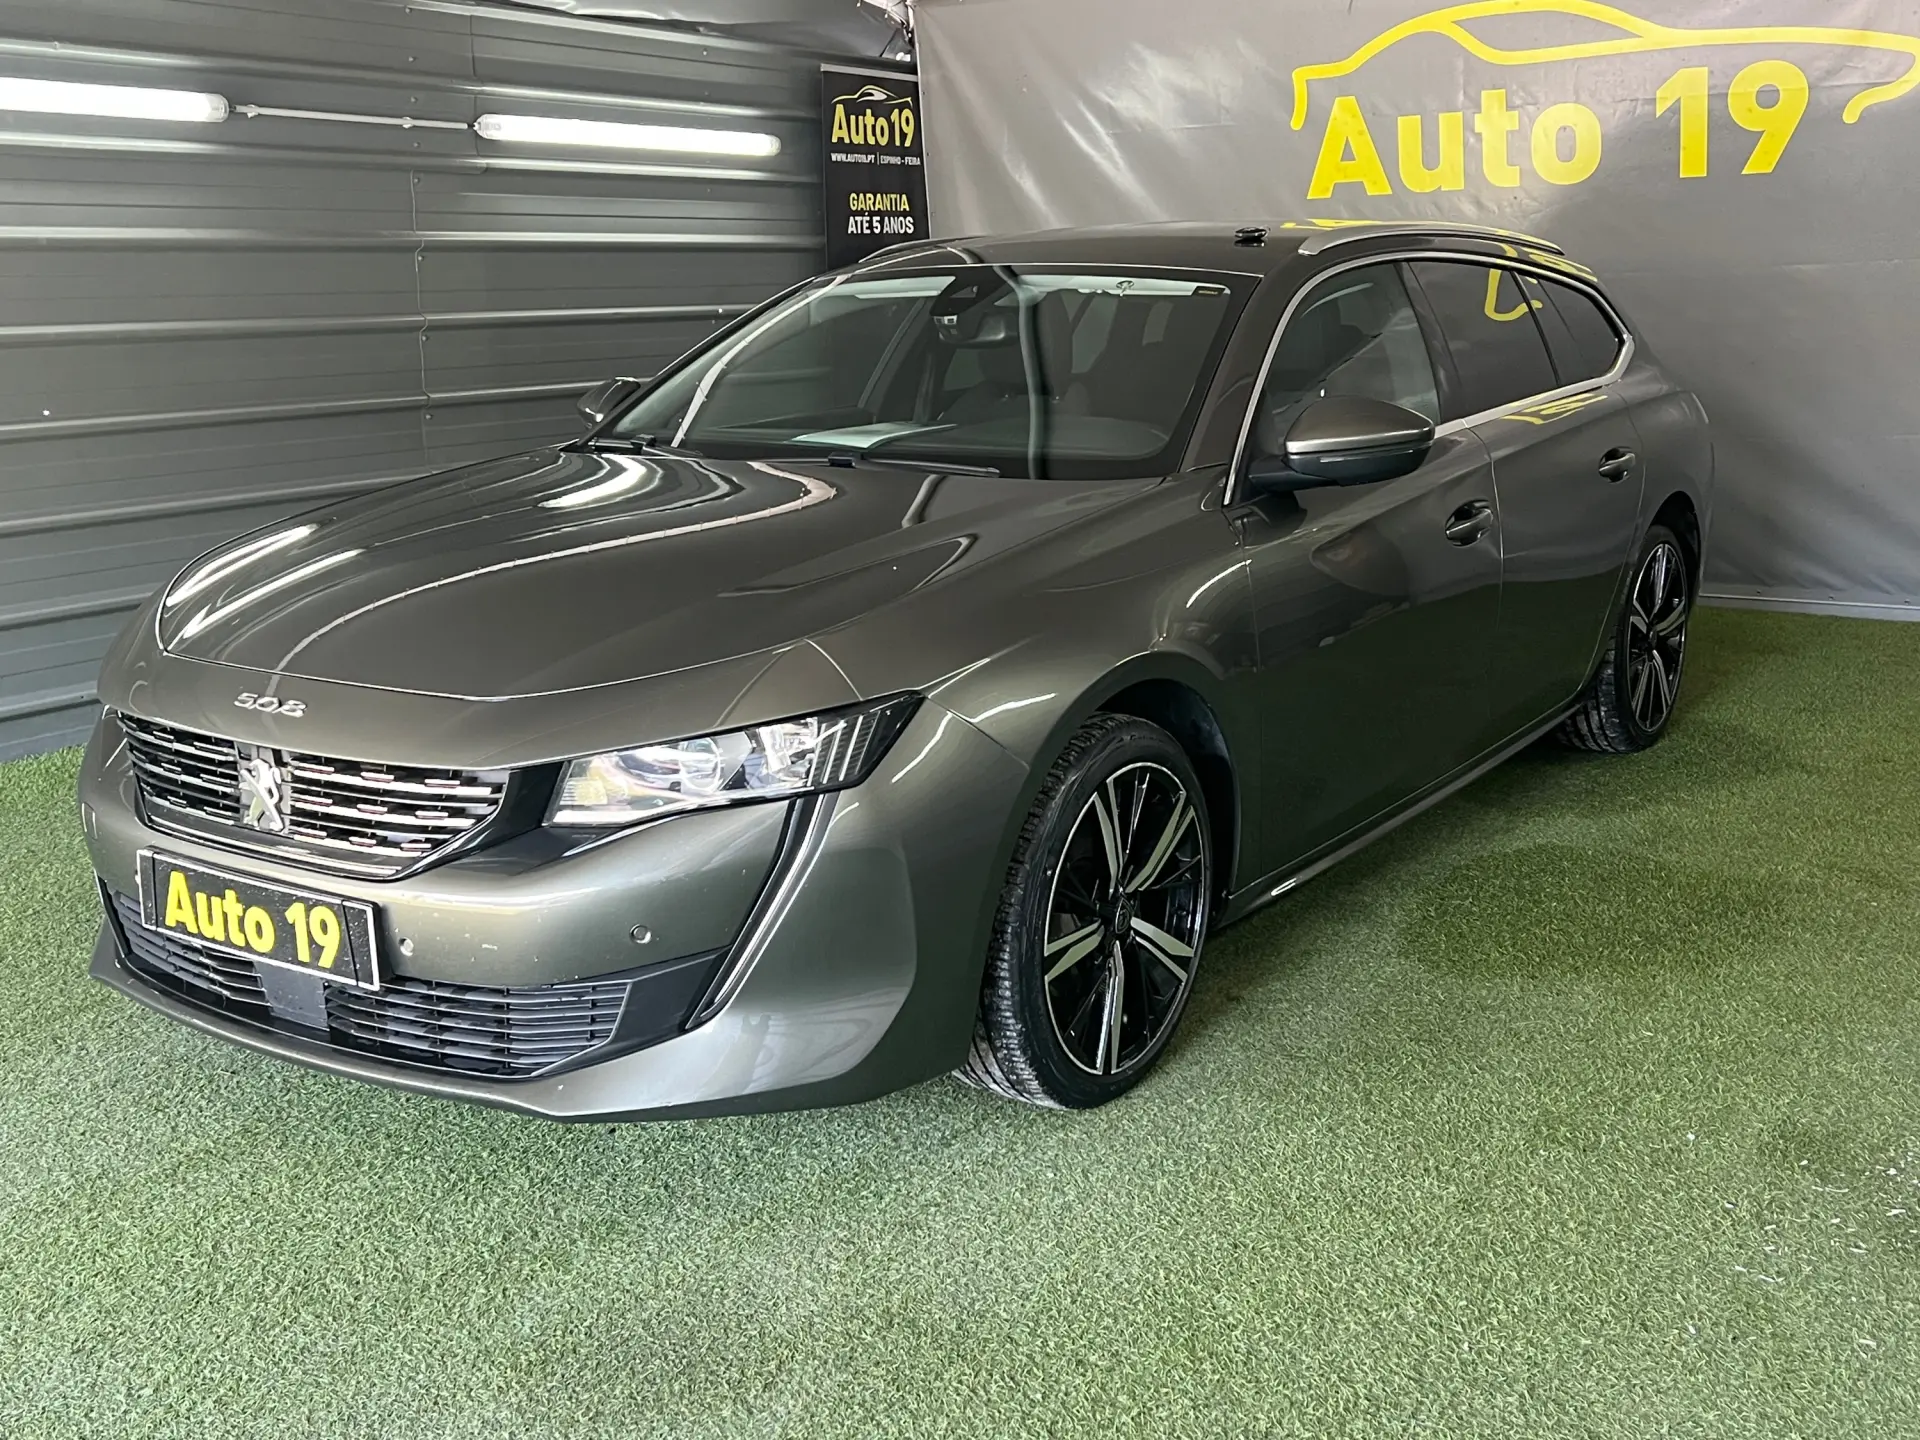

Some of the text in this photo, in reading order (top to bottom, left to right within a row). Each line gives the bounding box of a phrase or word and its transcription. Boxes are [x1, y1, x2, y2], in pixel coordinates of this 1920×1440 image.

[1307, 60, 1809, 199] Auto 19
[904, 156, 921, 165] FEIRA
[849, 192, 910, 212] GARANTIA
[847, 212, 914, 234] ATÉ 5 ANOS
[233, 692, 307, 718] 508
[164, 870, 341, 969] Auto 19
